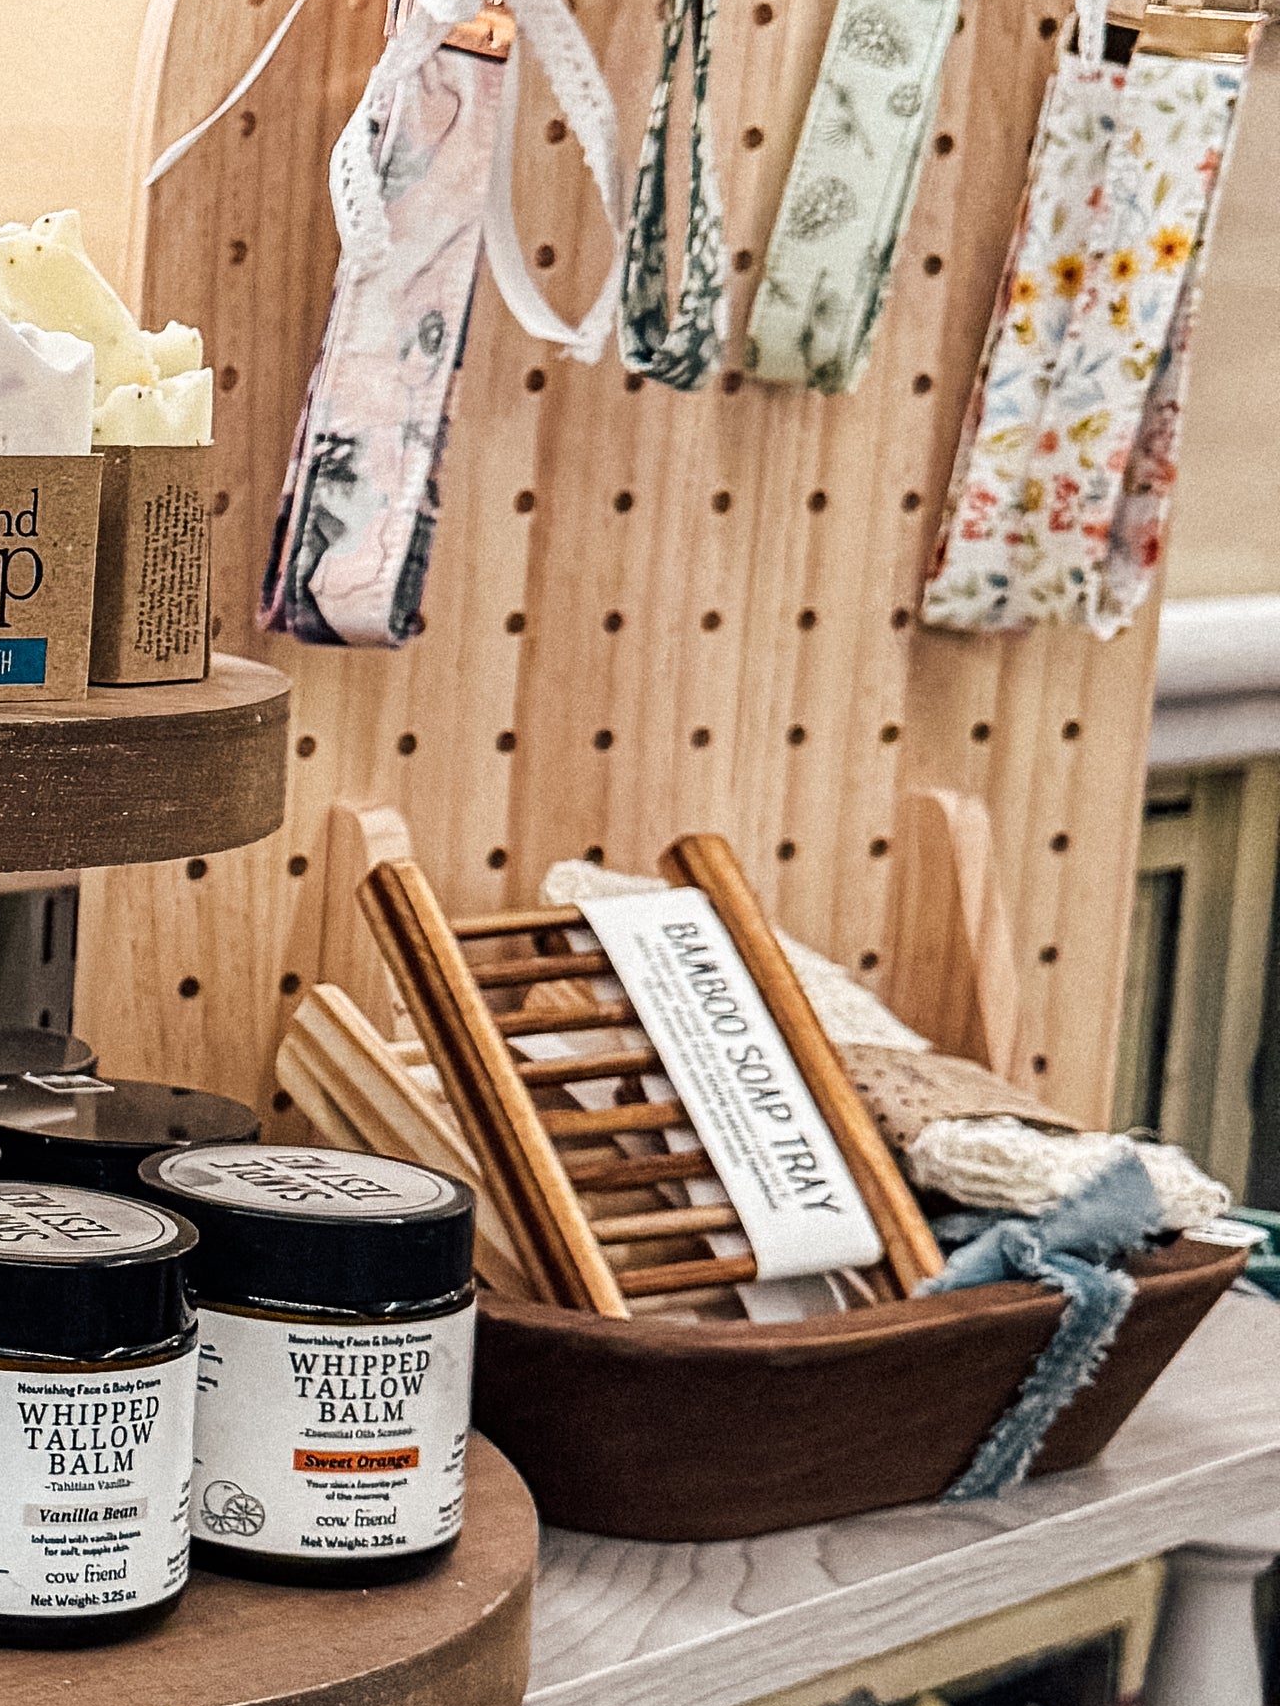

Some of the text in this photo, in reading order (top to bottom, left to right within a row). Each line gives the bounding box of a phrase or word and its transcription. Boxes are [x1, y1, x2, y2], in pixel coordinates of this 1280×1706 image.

[661, 921, 748, 1037] BAMBOO
[725, 1044, 793, 1123] SOAP
[770, 1131, 844, 1214] TRAY
[209, 1160, 334, 1200] SAMPLE
[304, 1173, 401, 1200] TEST
[25, 1212, 121, 1241] TEST
[288, 1350, 430, 1376] WHIPPED
[17, 1382, 75, 1397] Nourishing
[77, 1383, 100, 1395] Face
[112, 1380, 135, 1393] Body
[295, 1373, 424, 1399] TALLOW
[17, 1396, 159, 1426] WHIPPED
[318, 1399, 405, 1423] BALM
[24, 1420, 153, 1451] TALLOW
[48, 1448, 135, 1476] BALM
[304, 1454, 411, 1469] Sweet Orange
[40, 1505, 138, 1523] Vanilla Bean
[316, 1506, 397, 1526] cow friend
[45, 1559, 127, 1584] cow friend
[31, 1594, 53, 1607] Net
[55, 1593, 100, 1609] Weight:
[102, 1590, 124, 1603] 3.25
